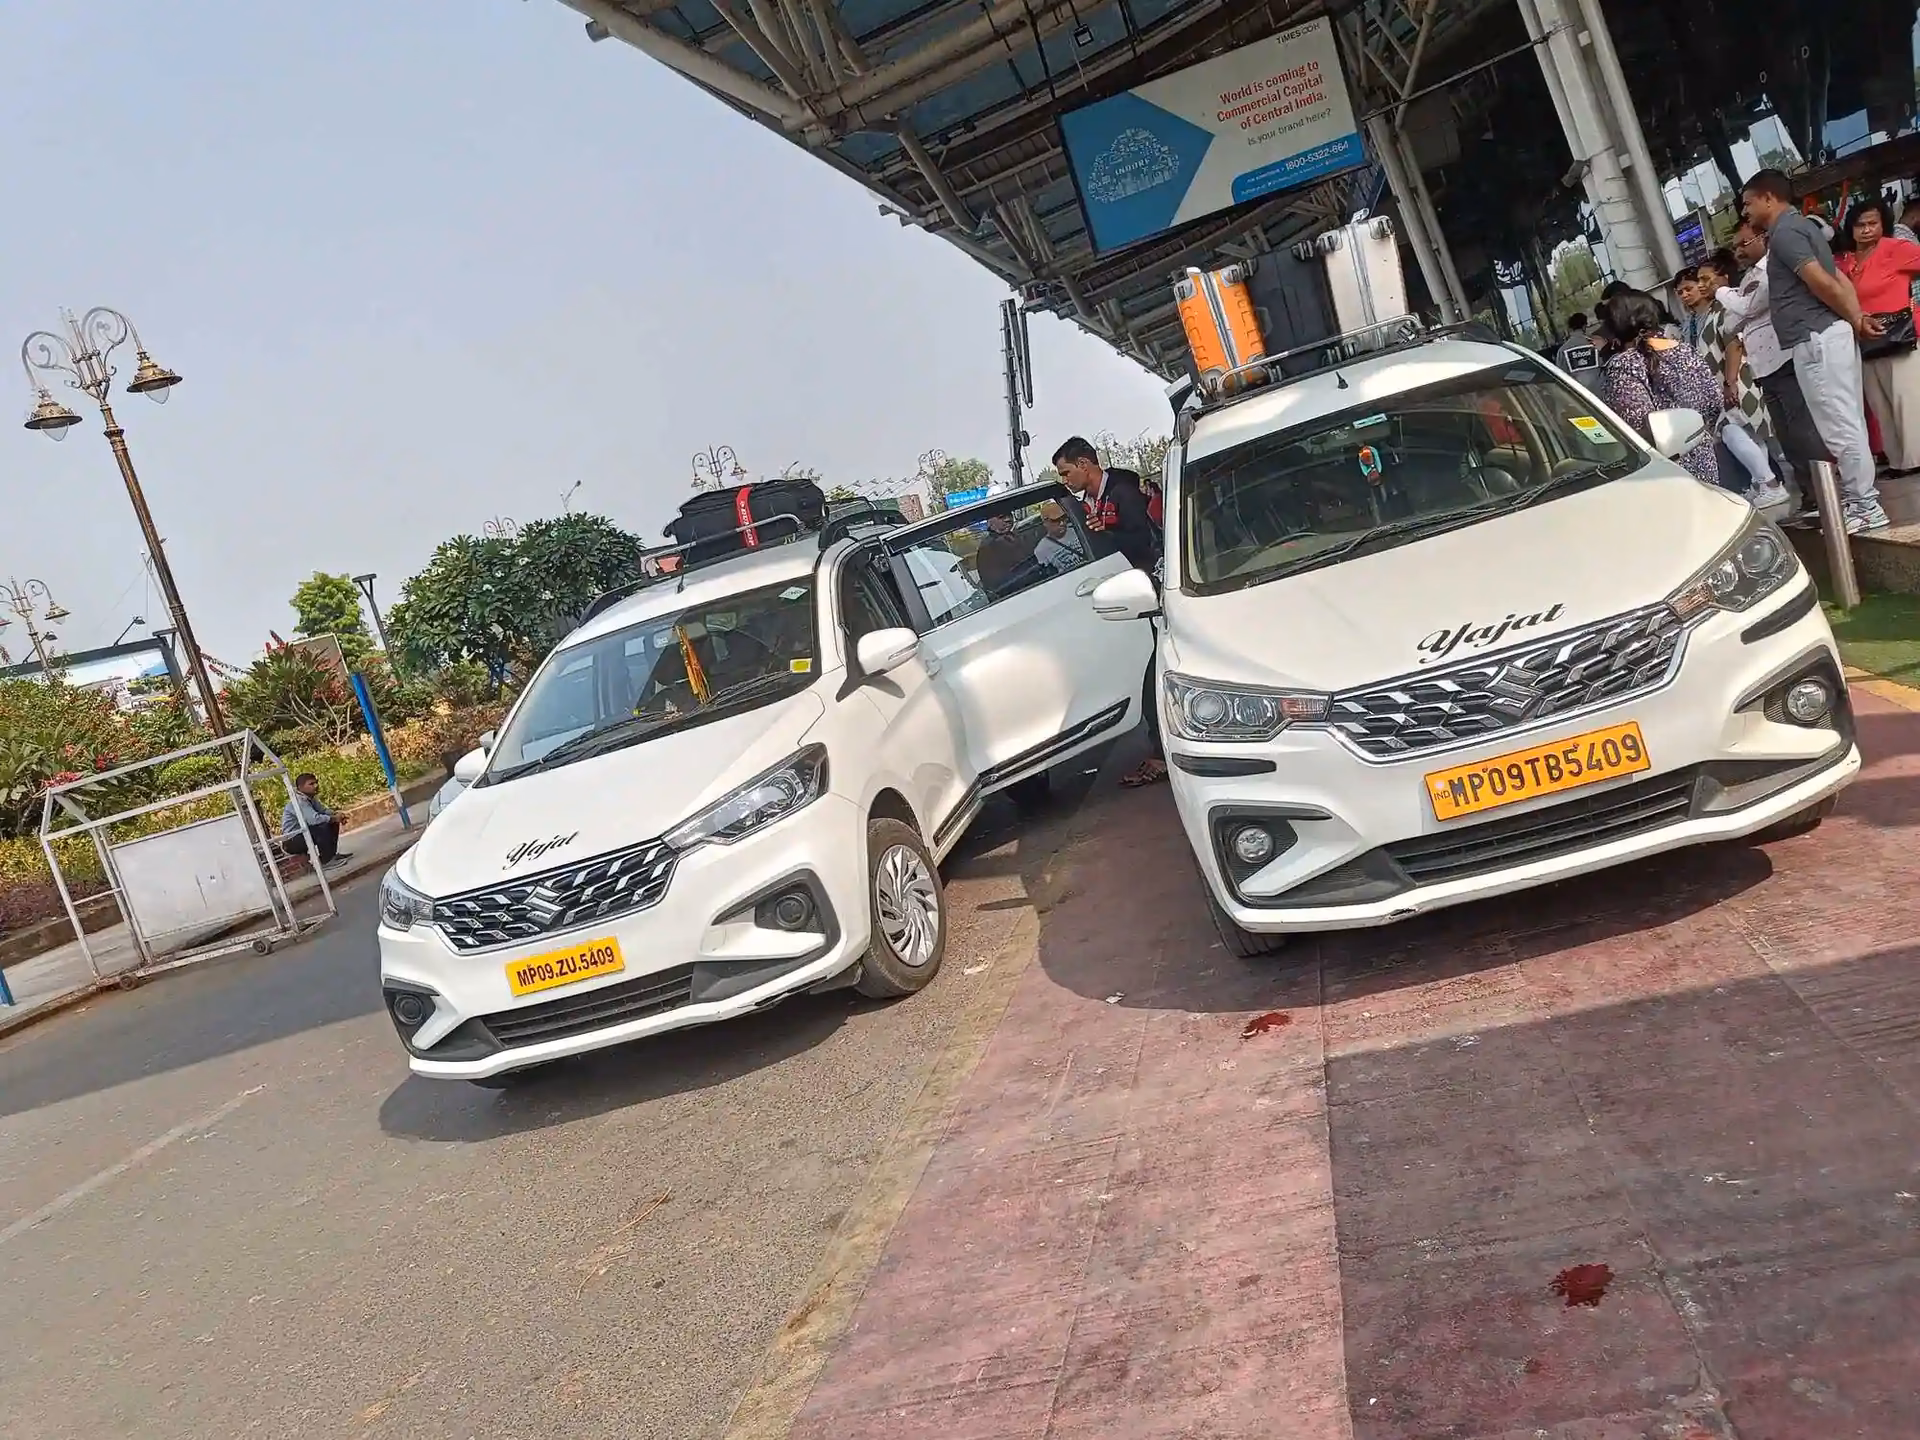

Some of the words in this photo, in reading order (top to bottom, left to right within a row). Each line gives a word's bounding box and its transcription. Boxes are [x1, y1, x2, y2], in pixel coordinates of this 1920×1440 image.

[1217, 89, 1281, 122] Commercial
[1283, 73, 1324, 98] Capital
[1219, 86, 1253, 105] World
[1253, 81, 1264, 93] is
[1265, 65, 1307, 88] coming
[1307, 60, 1319, 72] to
[1240, 117, 1253, 130] of
[1253, 102, 1294, 125] Central
[1295, 92, 1328, 110] India.
[1258, 130, 1276, 144] your
[1278, 119, 1304, 135] brand
[1305, 108, 1332, 125] here?
[1285, 140, 1349, 171] 1800-5322-664
[1572, 349, 1592, 359] School
[1417, 603, 1568, 664] Yajat
[1447, 734, 1642, 808] MP09TB5409
